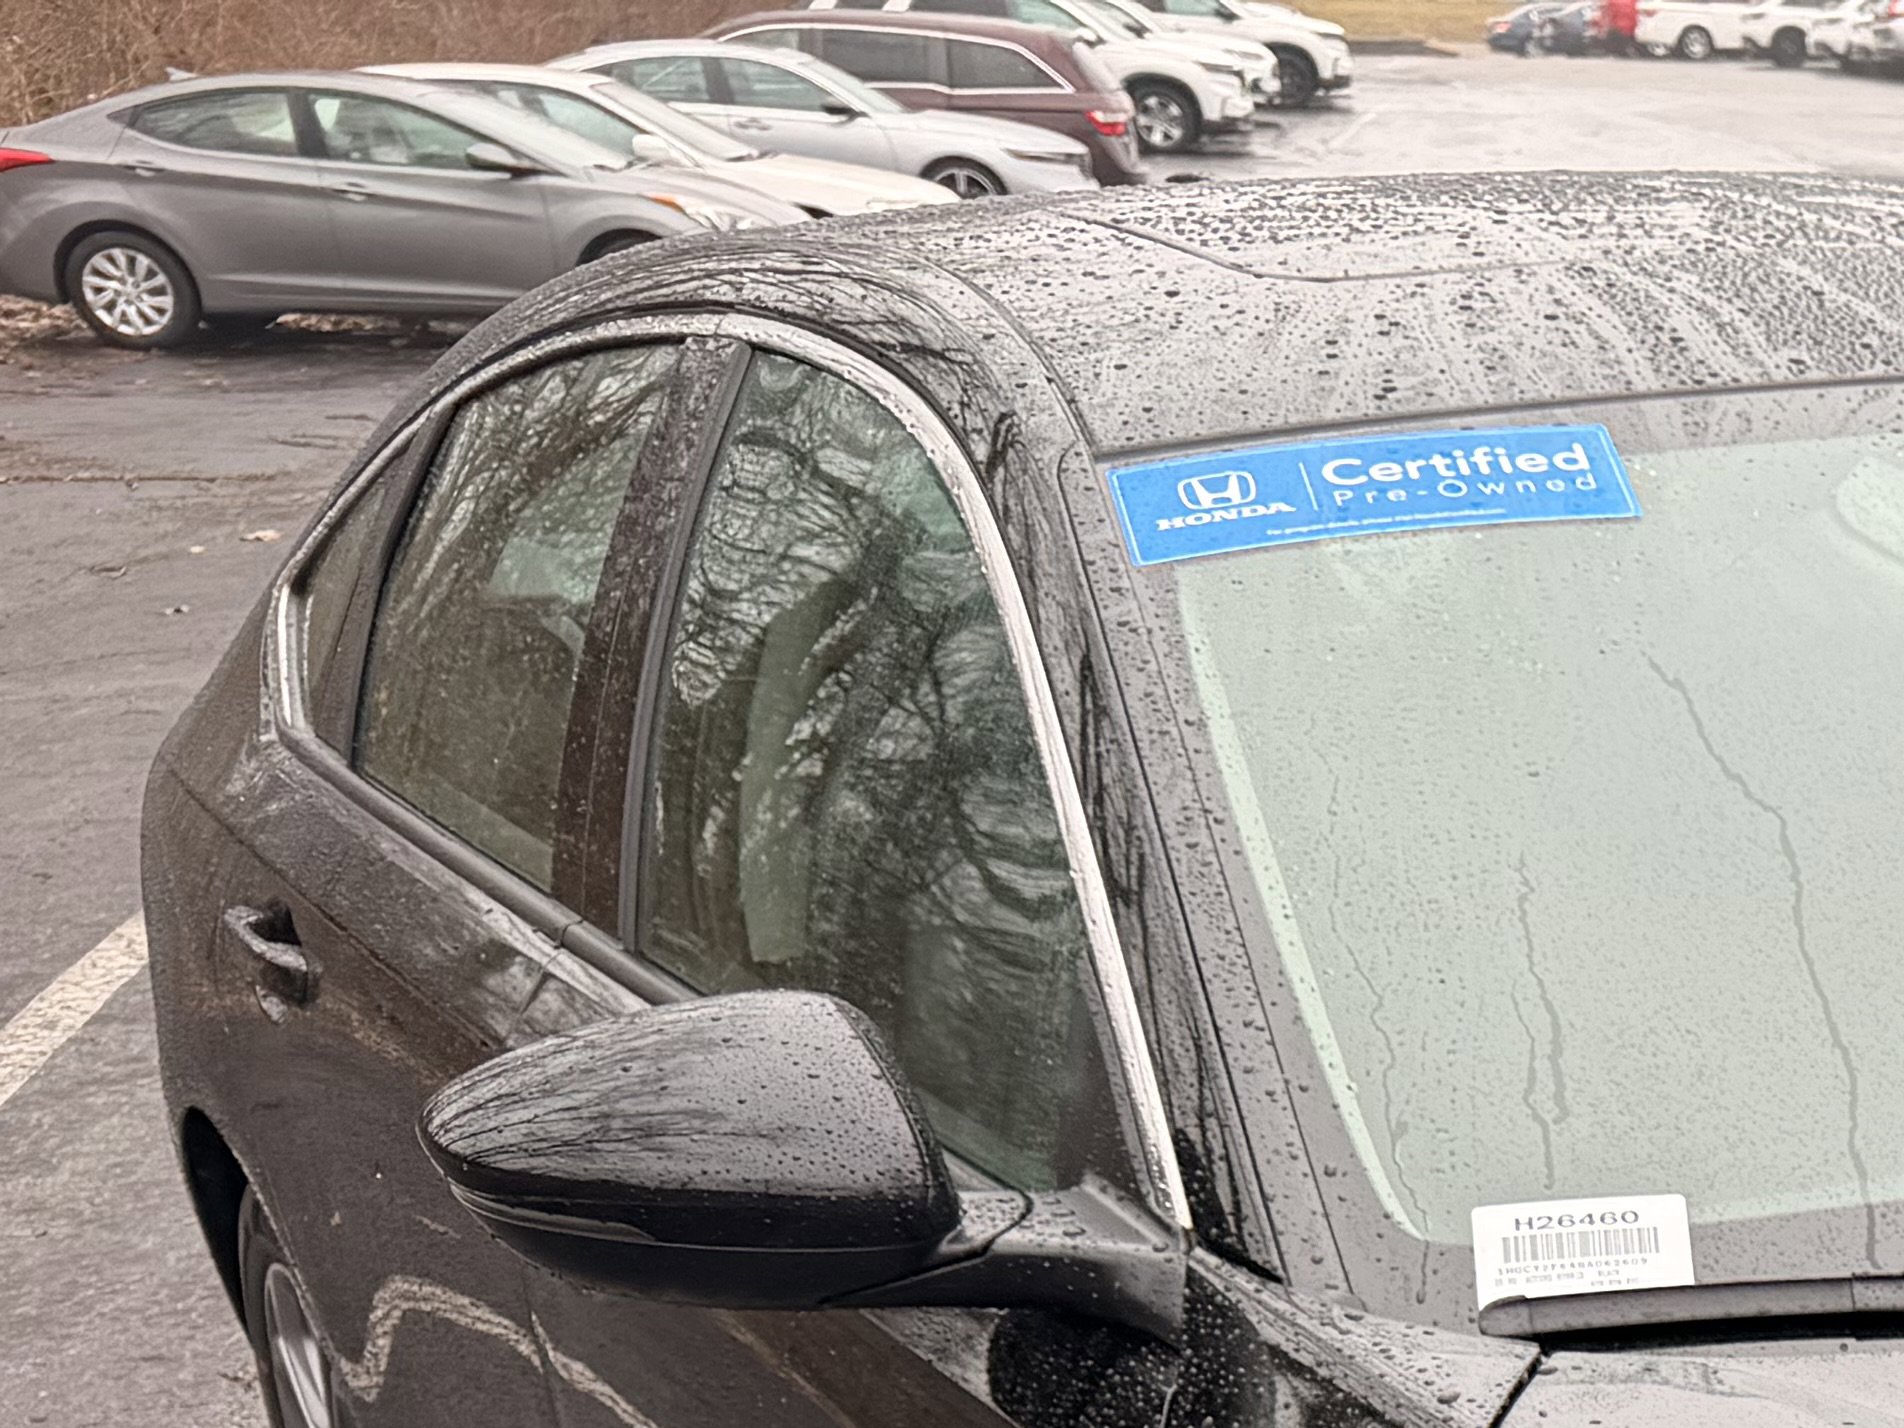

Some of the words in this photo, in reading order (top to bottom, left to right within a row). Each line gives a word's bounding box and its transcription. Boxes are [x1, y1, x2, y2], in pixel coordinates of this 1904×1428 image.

[1321, 441, 1591, 486] Certified
[1332, 472, 1598, 507] Pre-Owned
[1155, 501, 1297, 532] HONDA
[1514, 1209, 1640, 1232] H26460
